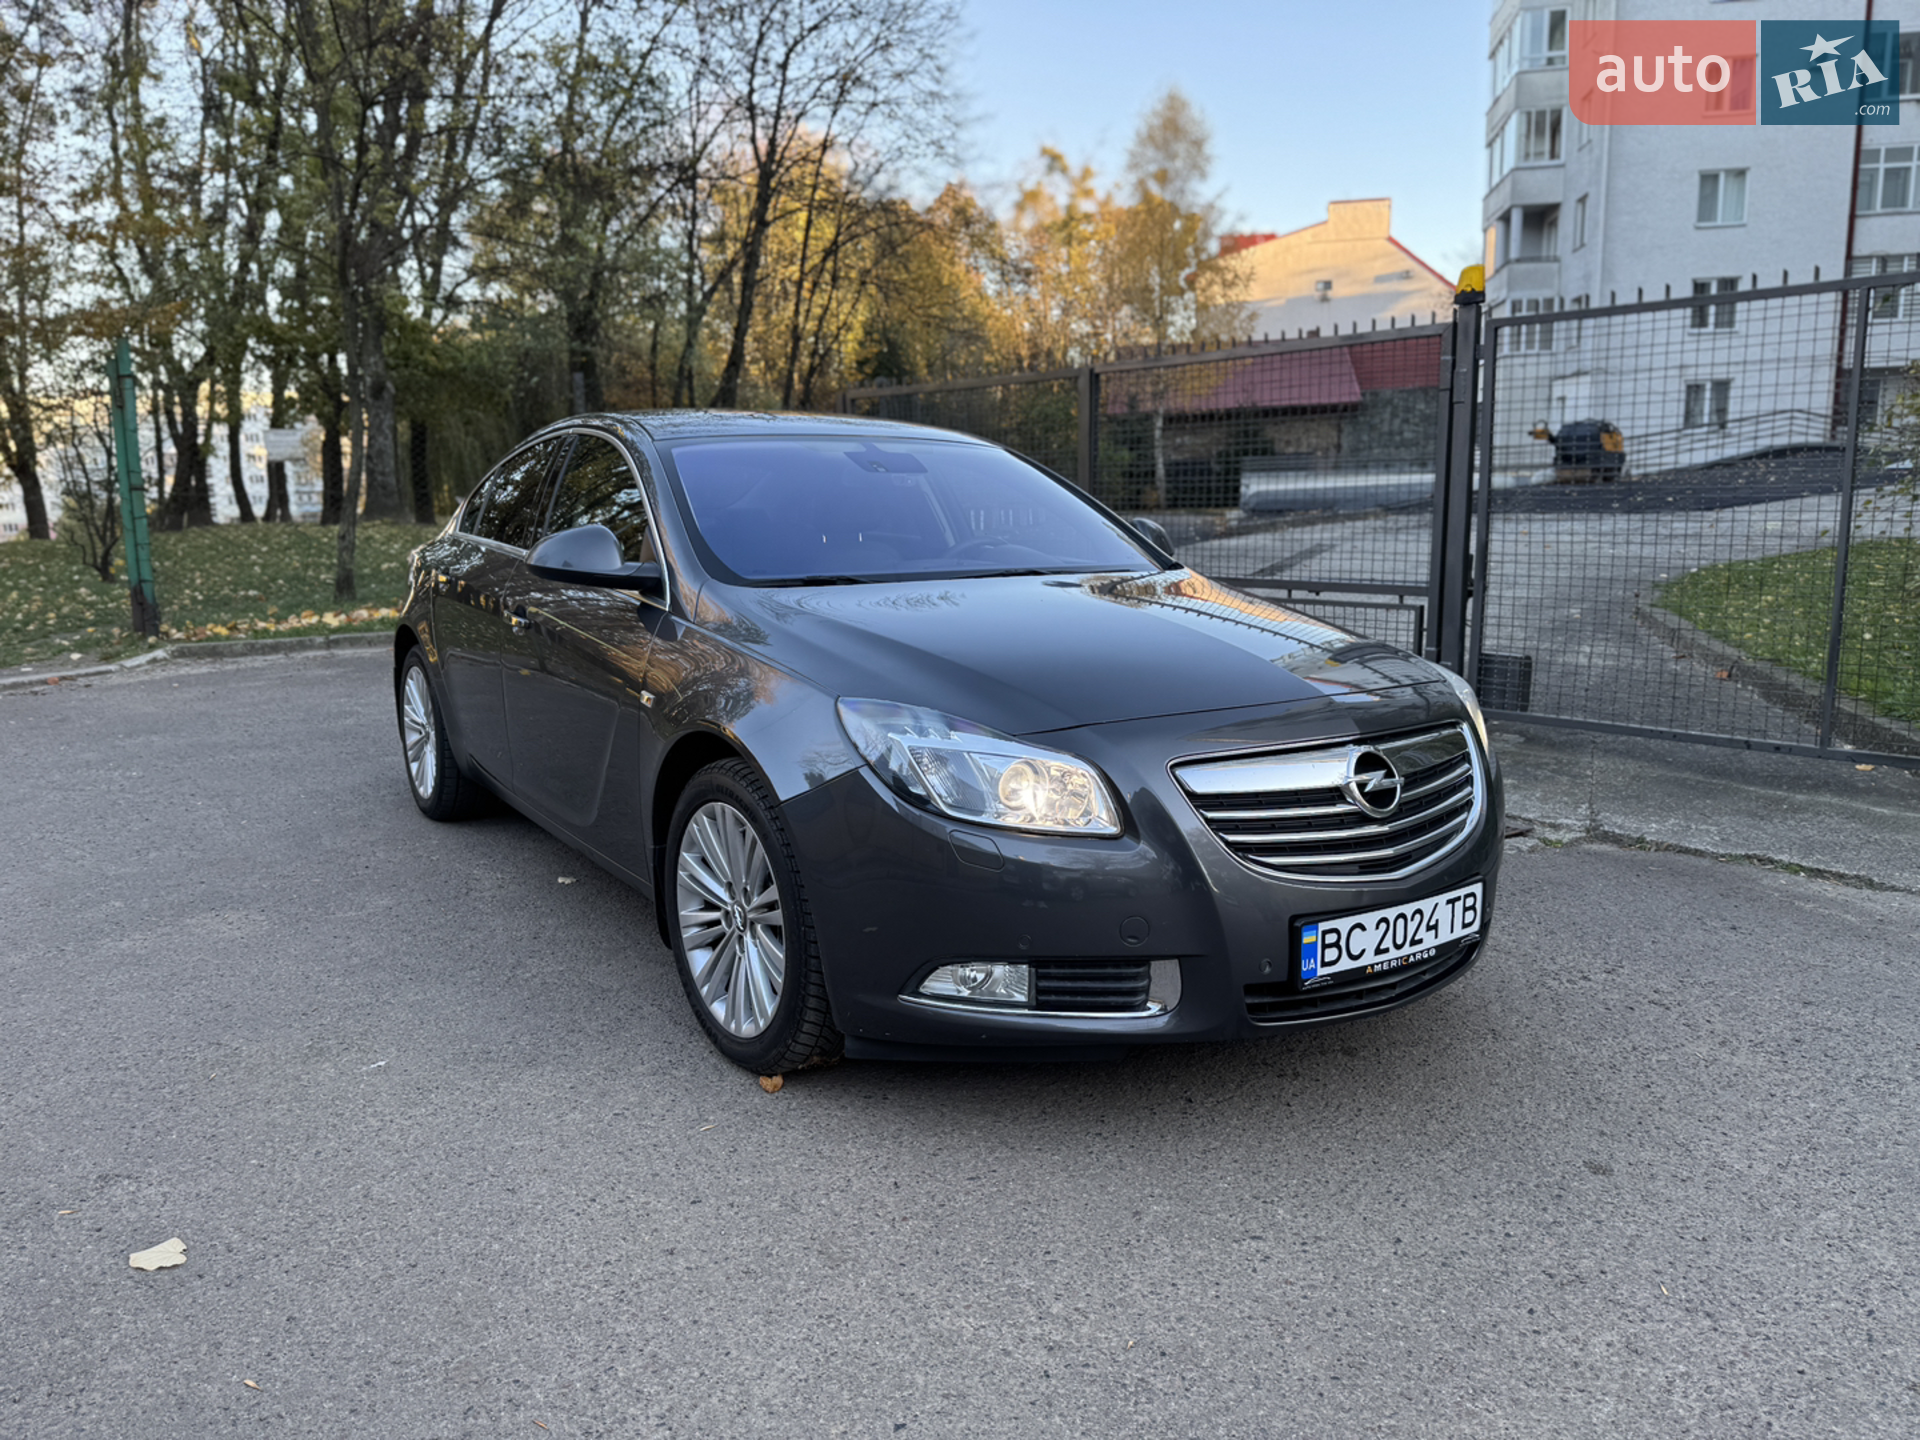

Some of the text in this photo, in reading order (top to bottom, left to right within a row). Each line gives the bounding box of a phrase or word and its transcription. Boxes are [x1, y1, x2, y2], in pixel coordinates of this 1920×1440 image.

[1320, 891, 1478, 968] BC 2024 TB
[1301, 958, 1316, 971] UA
[1365, 947, 1436, 974] AMERICARGO
